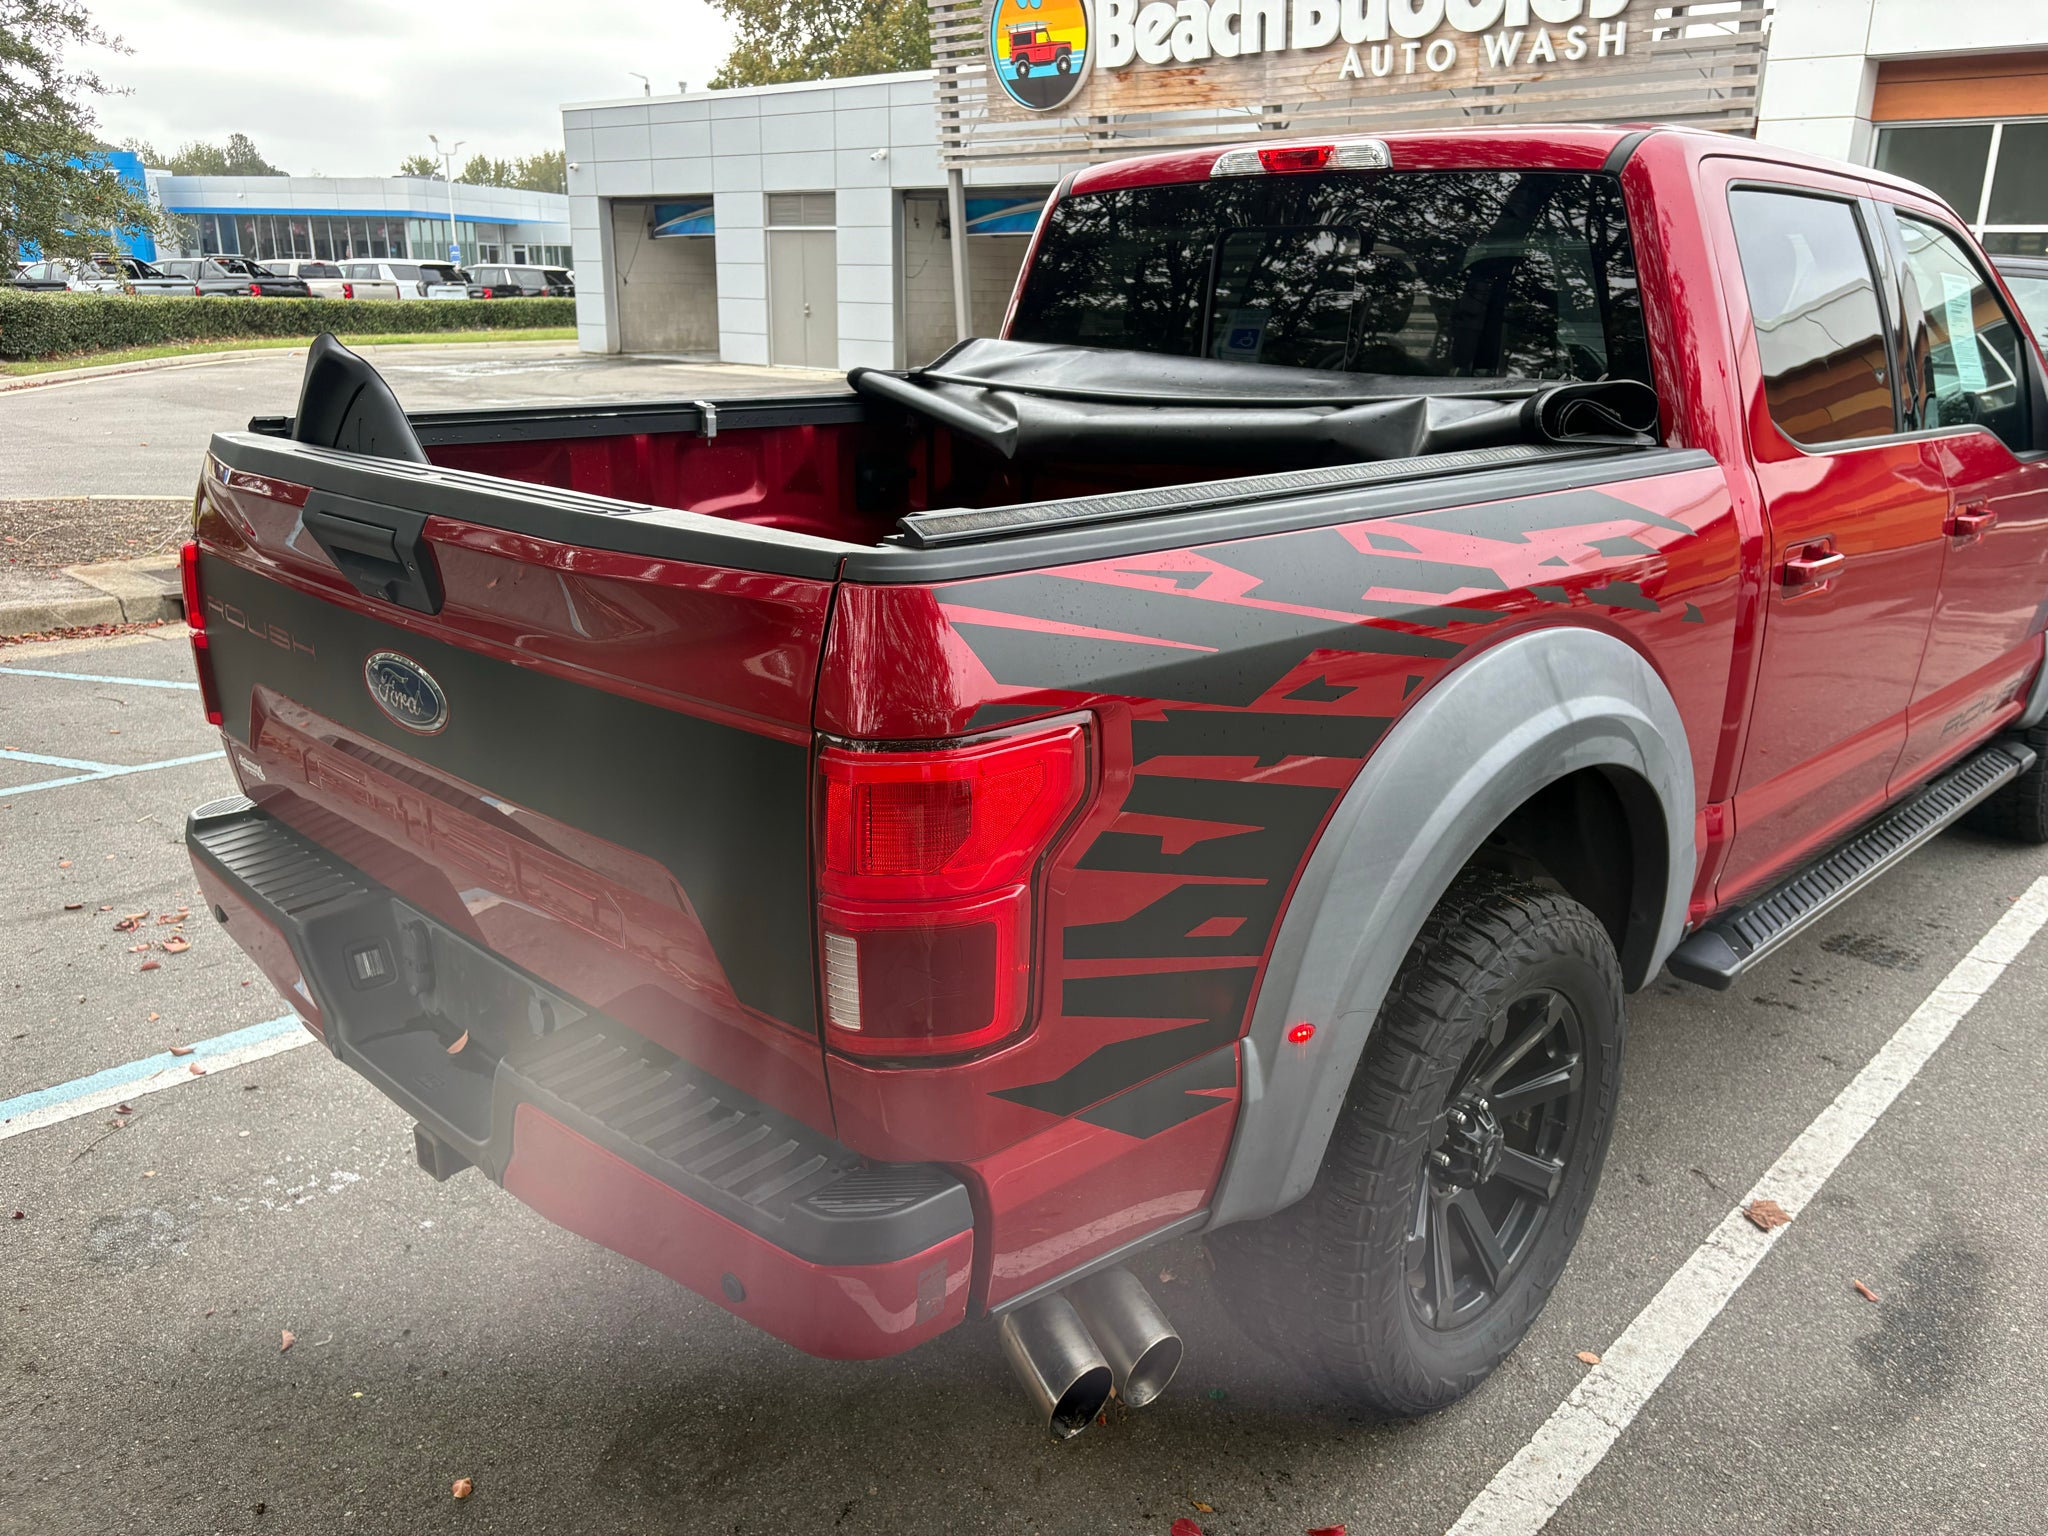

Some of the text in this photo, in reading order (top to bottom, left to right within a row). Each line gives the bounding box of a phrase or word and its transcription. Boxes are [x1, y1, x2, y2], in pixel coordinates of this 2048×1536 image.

[1338, 21, 1627, 80] AUTO WASH
[207, 595, 317, 661] ROUSH
[379, 667, 425, 716] Ford
